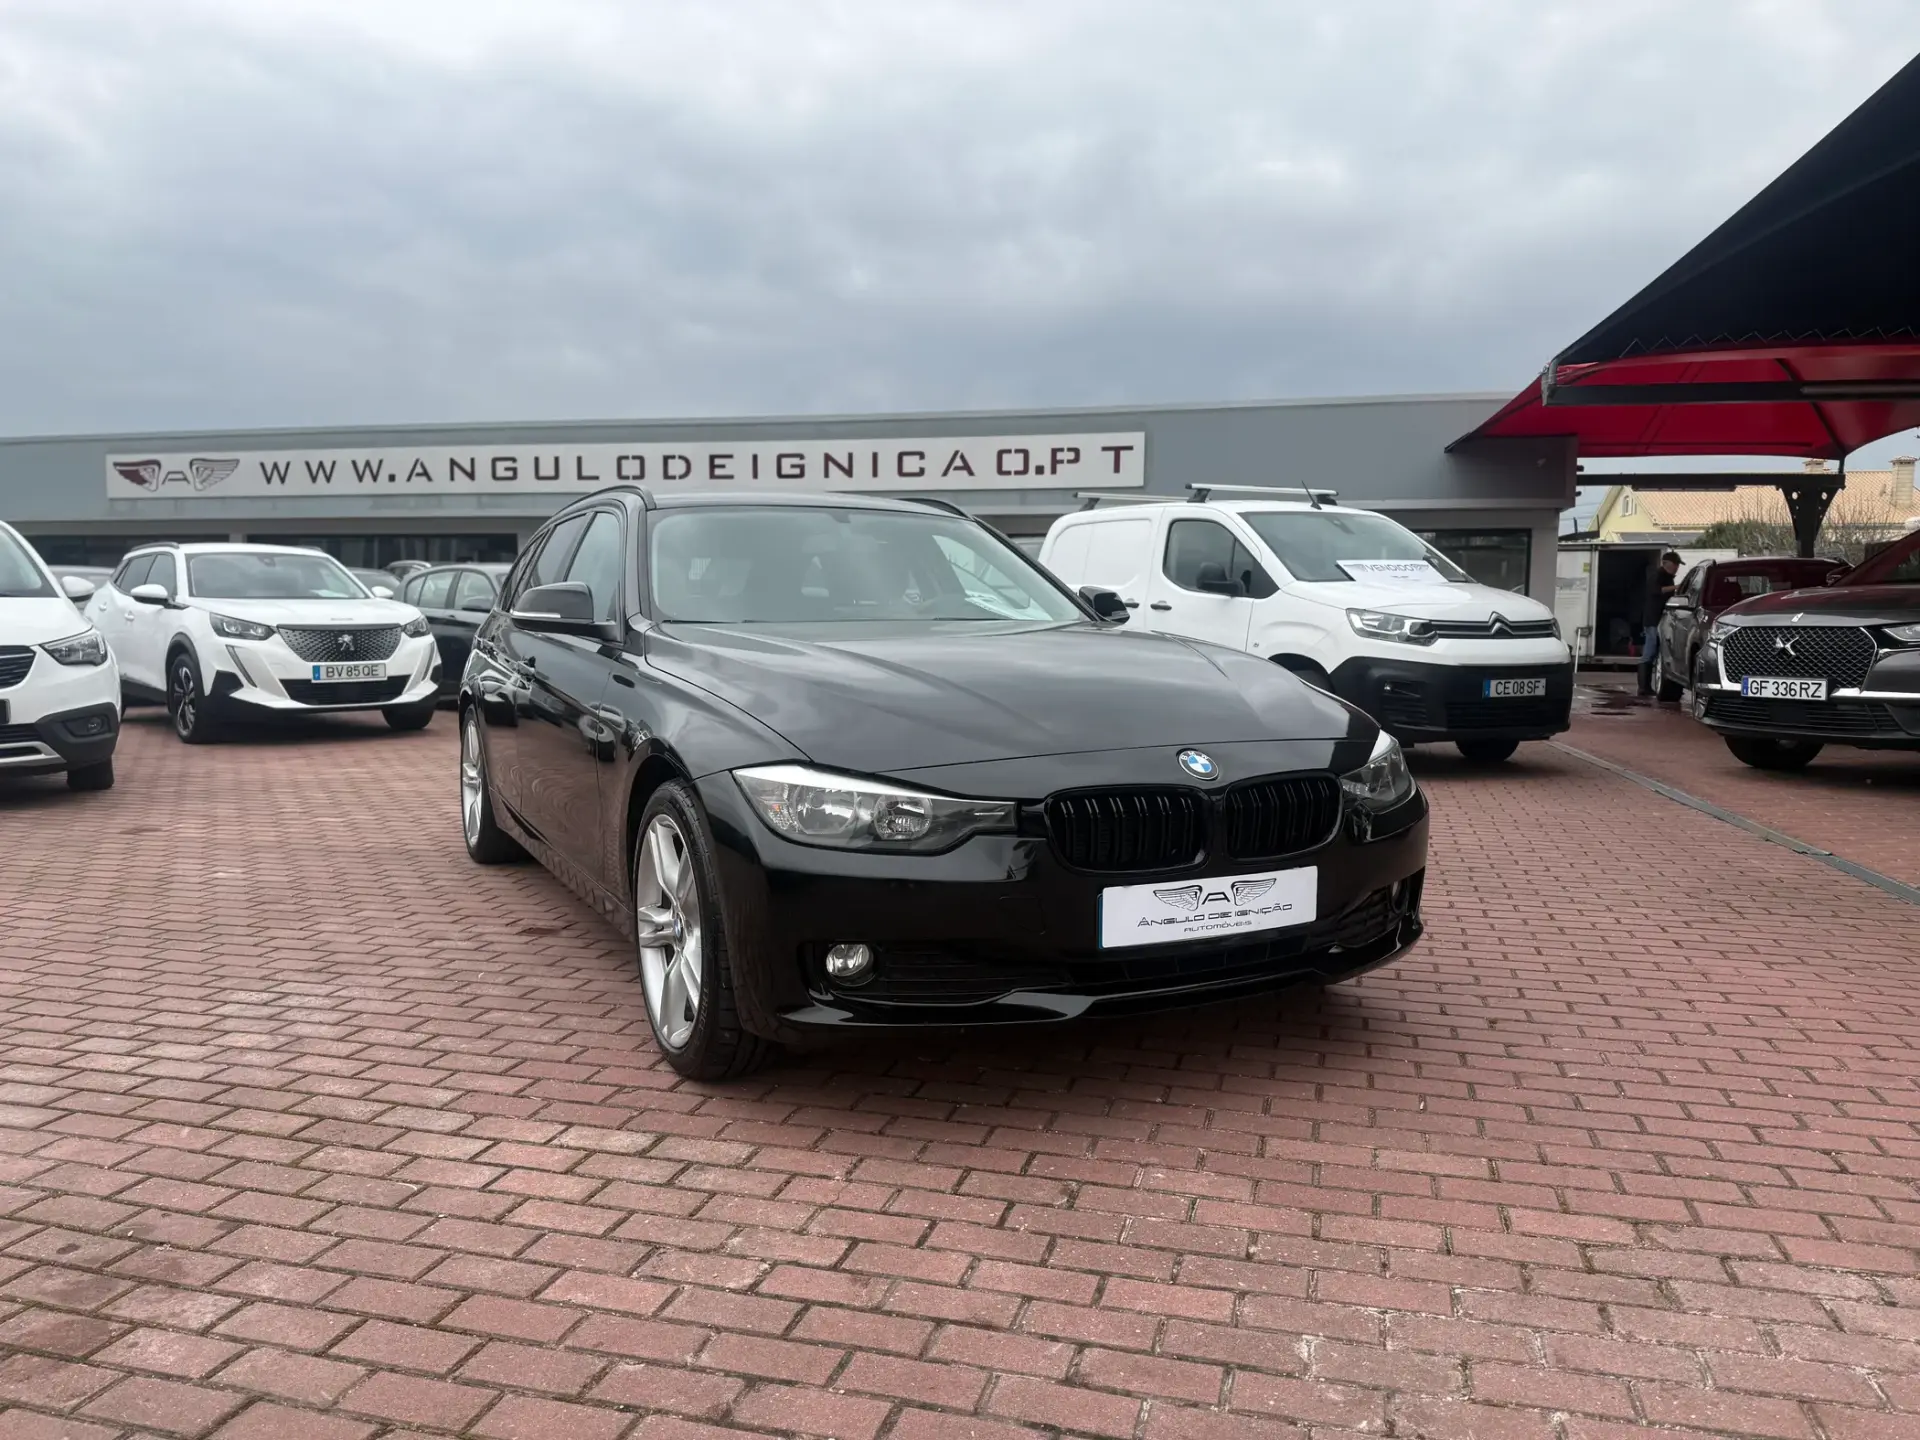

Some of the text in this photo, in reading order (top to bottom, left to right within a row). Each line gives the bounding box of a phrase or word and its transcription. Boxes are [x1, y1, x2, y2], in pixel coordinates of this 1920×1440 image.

[326, 667, 344, 678] BV
[346, 666, 361, 677] 85
[1495, 680, 1541, 695] CE 08 SF
[1750, 680, 1823, 698] GF 336 RZ
[1137, 902, 1293, 928] ÂNGULO DE IGNIÇÃO
